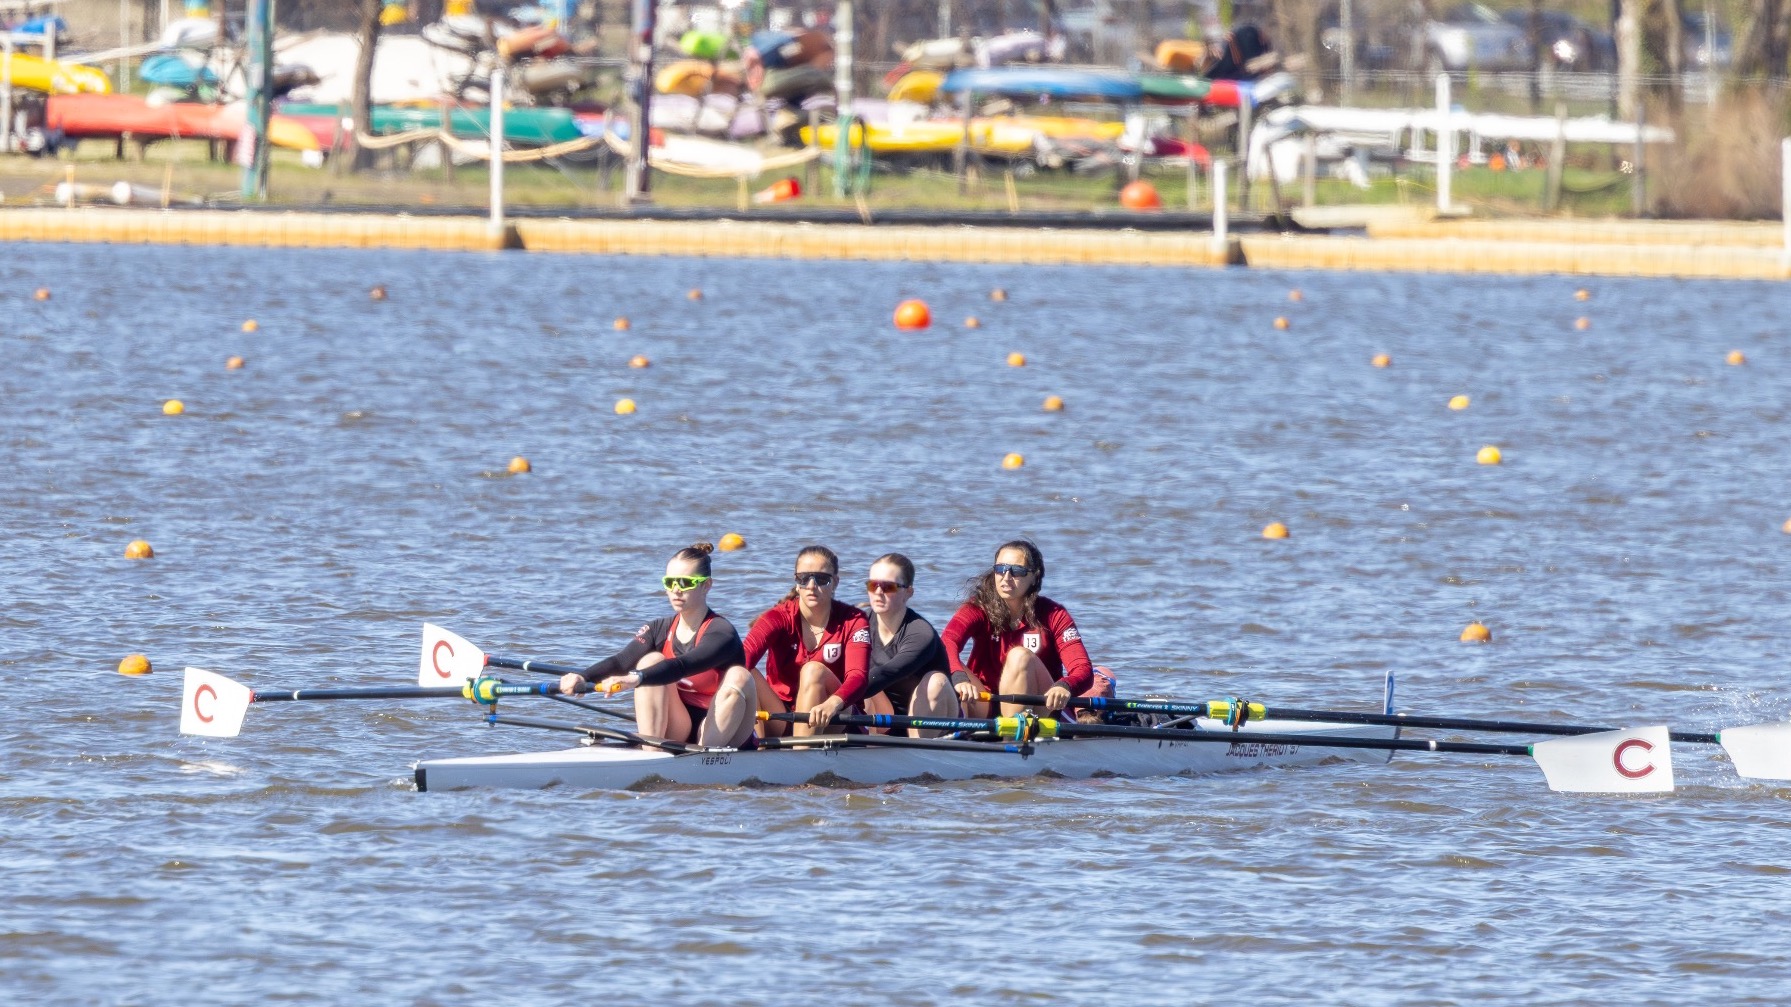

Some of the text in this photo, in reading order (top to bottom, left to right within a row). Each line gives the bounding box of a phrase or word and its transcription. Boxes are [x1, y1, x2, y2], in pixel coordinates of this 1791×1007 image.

[1026, 637, 1037, 648] 13
[827, 647, 838, 658] 13
[433, 639, 455, 679] C
[194, 683, 218, 723] C
[1170, 704, 1198, 712] SKINNY
[701, 756, 732, 765] VESPOLI
[1612, 737, 1657, 780] C
